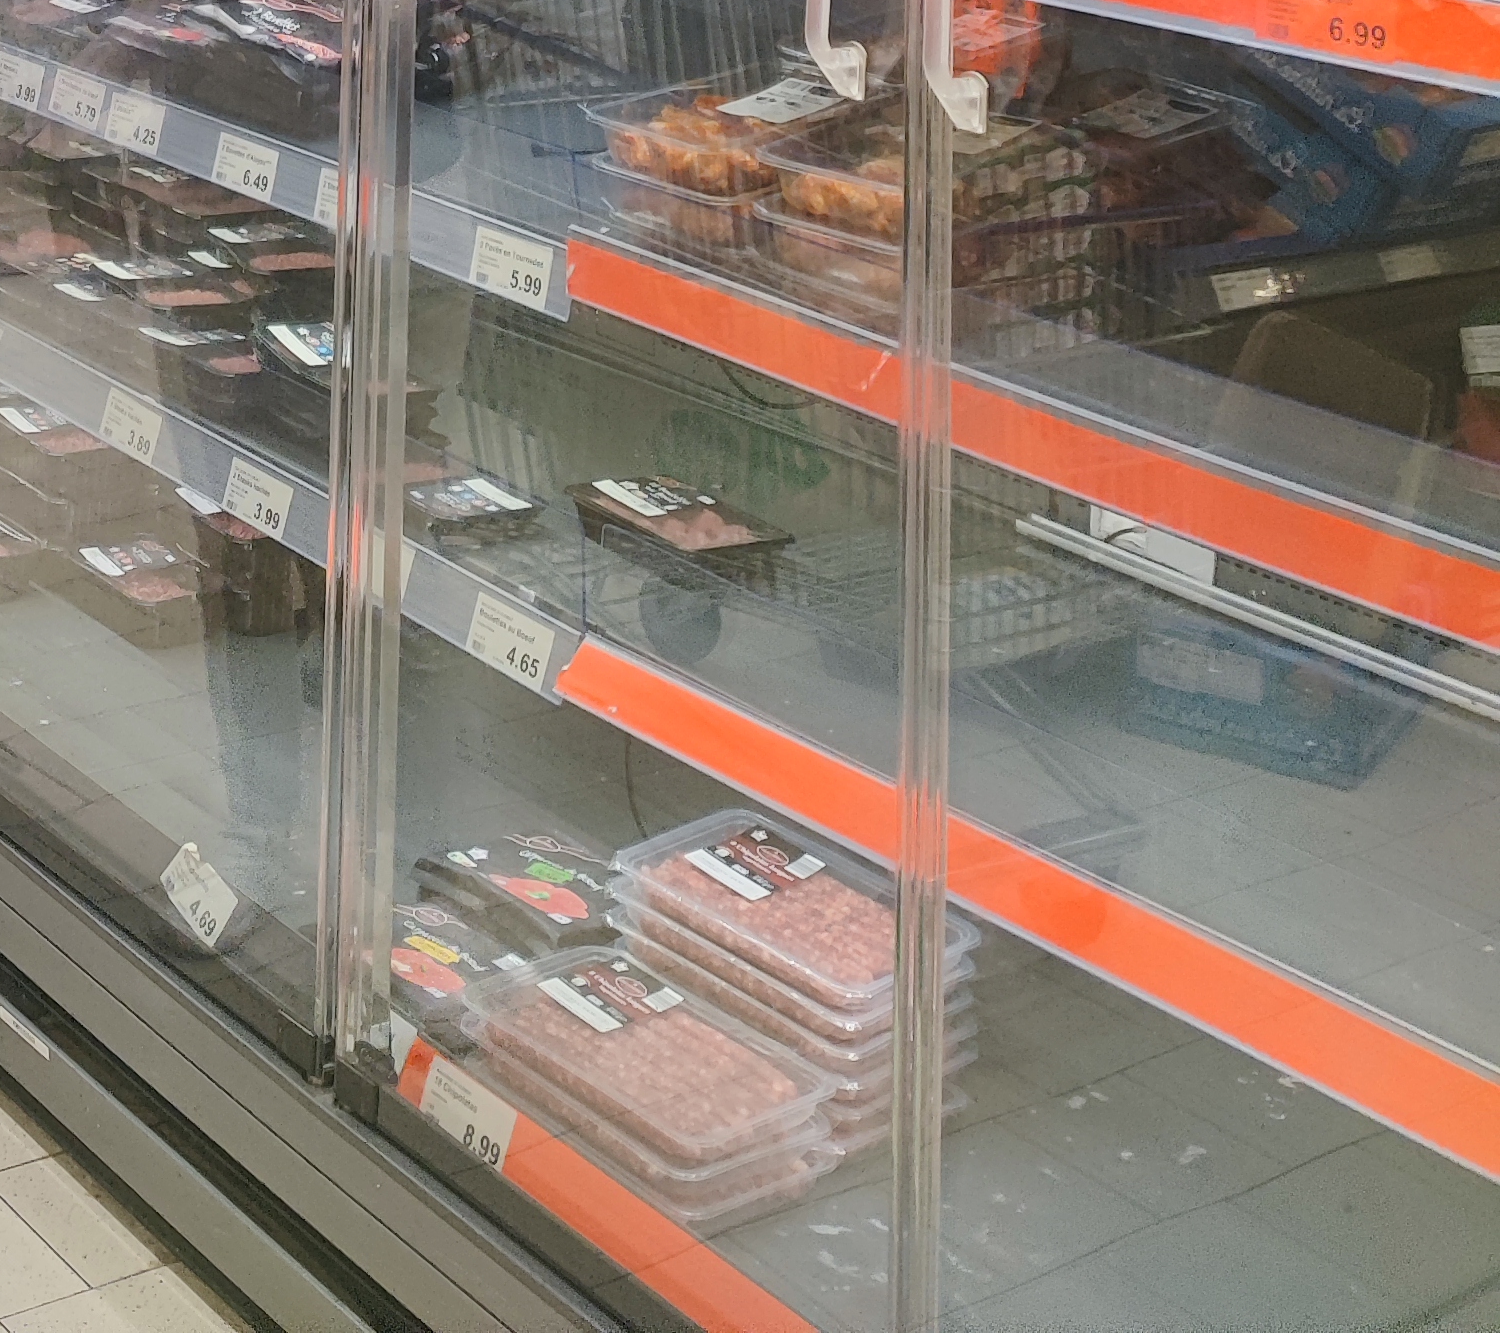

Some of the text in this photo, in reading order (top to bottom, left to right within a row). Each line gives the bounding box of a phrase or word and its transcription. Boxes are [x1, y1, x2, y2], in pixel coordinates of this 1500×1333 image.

[1328, 15, 1388, 51] 6.99
[74, 100, 97, 123] 5.79
[132, 125, 157, 147] 4.25
[242, 168, 269, 193] 6.49
[510, 269, 542, 297] 5.99
[253, 502, 281, 531] 3.99
[506, 645, 540, 679] 4.65
[188, 898, 217, 937] 4.69
[462, 1123, 501, 1166] 8.99
